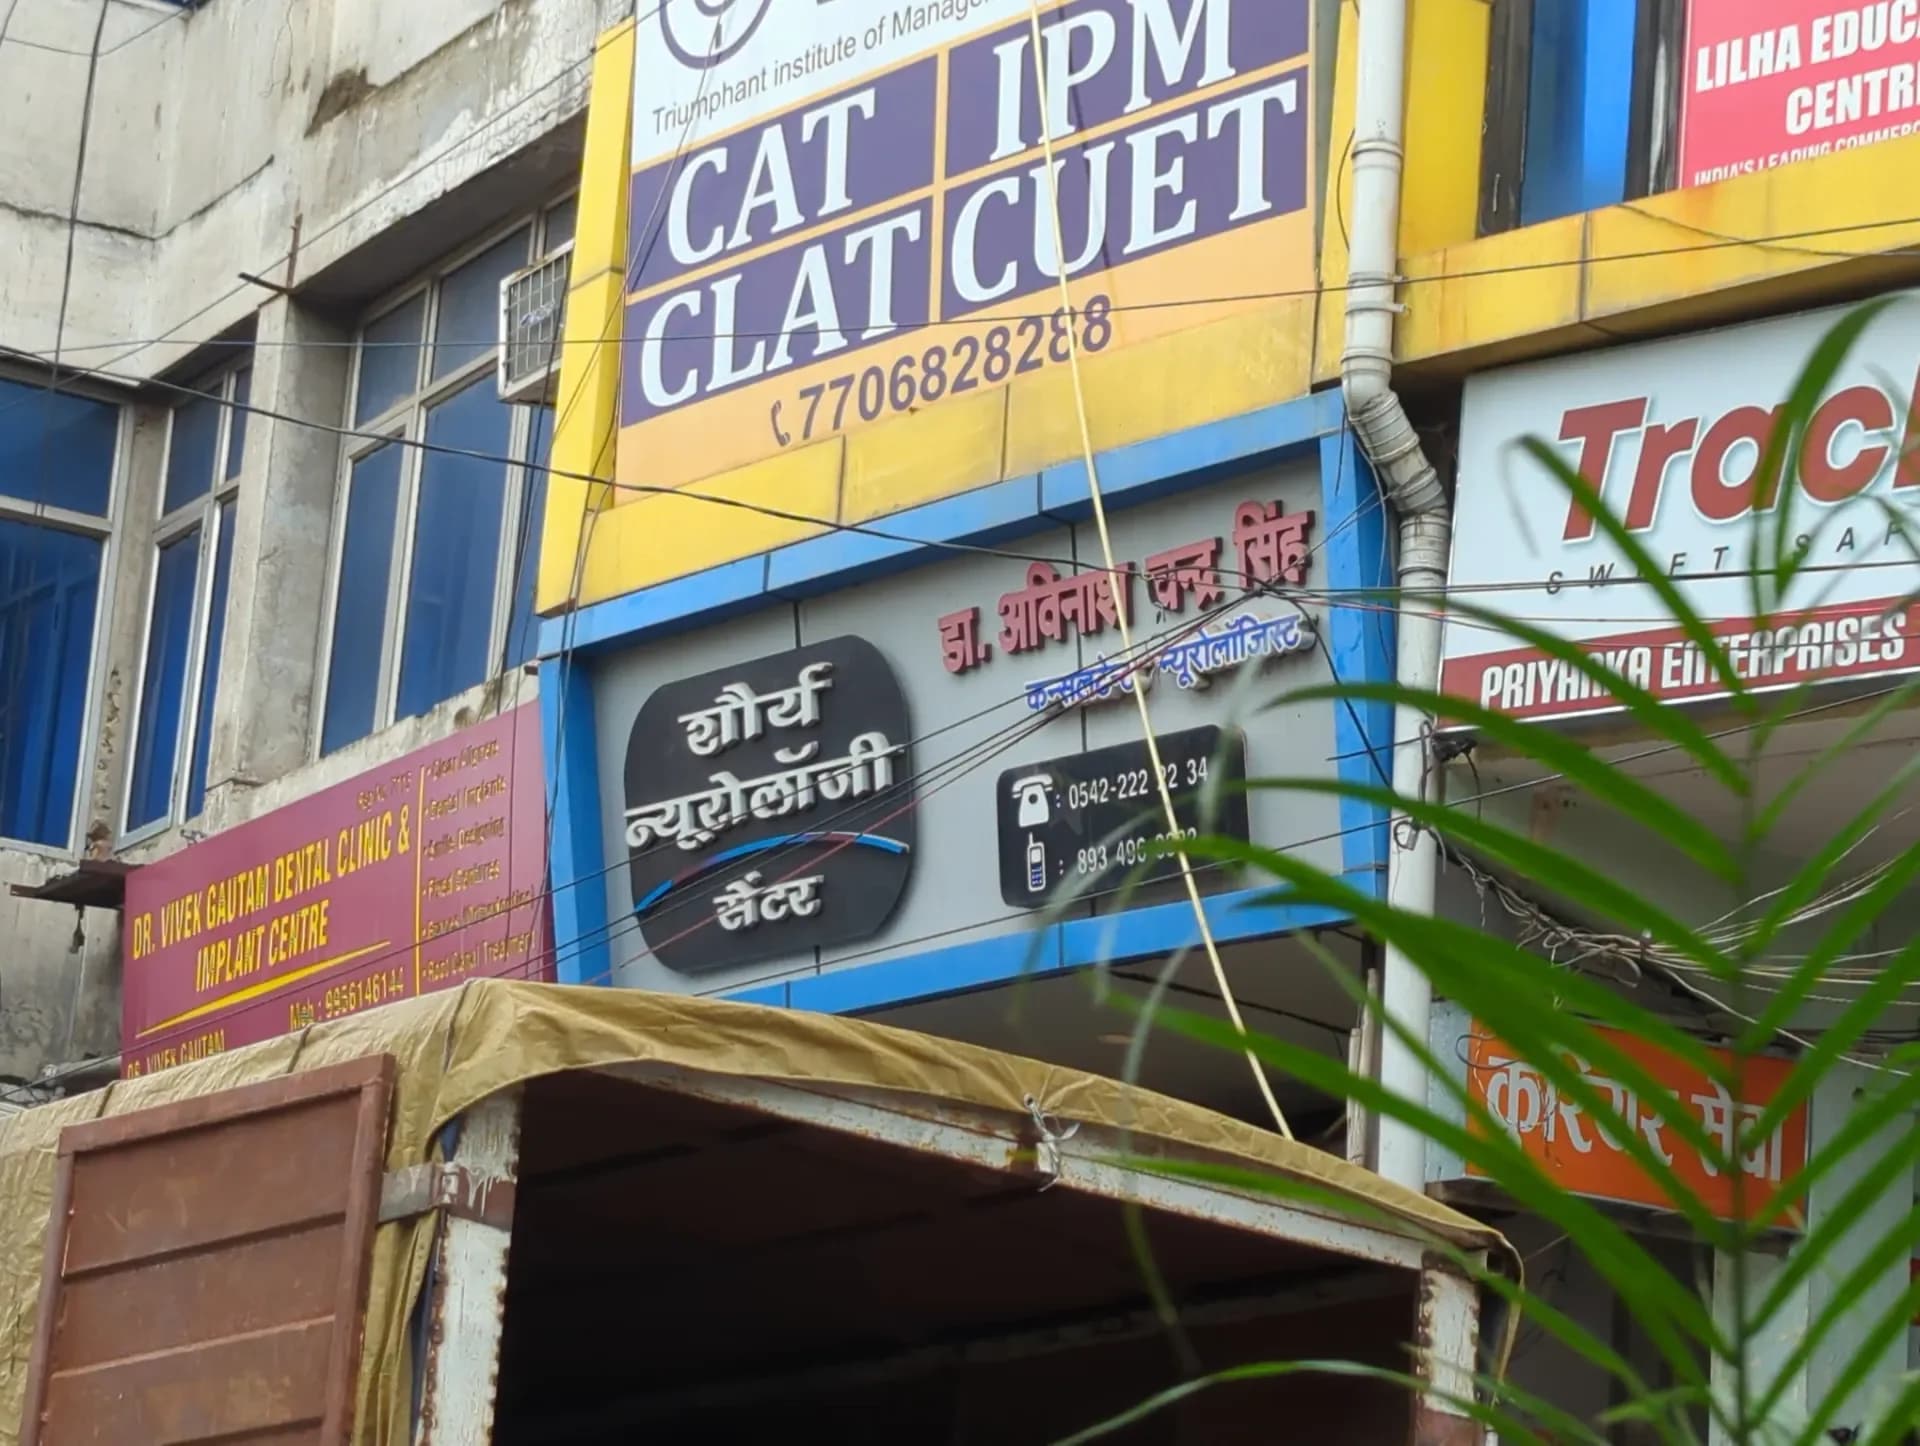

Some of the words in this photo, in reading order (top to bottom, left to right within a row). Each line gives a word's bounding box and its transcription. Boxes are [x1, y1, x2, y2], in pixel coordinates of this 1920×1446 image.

[652, 67, 768, 136] Triumphant
[773, 35, 857, 86] institute
[864, 15, 886, 50] of
[990, 0, 1236, 161] IPM
[1696, 23, 1801, 93] LILHA
[1810, 0, 1920, 64] EDUC
[1785, 61, 1920, 135] CENTR
[666, 88, 876, 267] CAT
[950, 79, 1297, 304] CUET
[640, 210, 922, 408] CLAT
[799, 294, 1113, 441] 7706828288
[1546, 546, 1729, 595] SWFT
[677, 662, 833, 756] शौर्य
[624, 731, 905, 850] न्यूरोलॉजी
[1068, 769, 1149, 810] 0542-222
[1187, 756, 1209, 786] 34
[132, 911, 156, 961] DR.
[160, 891, 203, 949] VIVEK
[206, 863, 269, 931] GAUTAM
[273, 838, 332, 904] DENTAL
[336, 810, 393, 878] CLINIC
[397, 804, 410, 855] &
[1077, 846, 1108, 875] 893
[195, 925, 265, 993] IMPLANT
[267, 899, 329, 967] CENTRE
